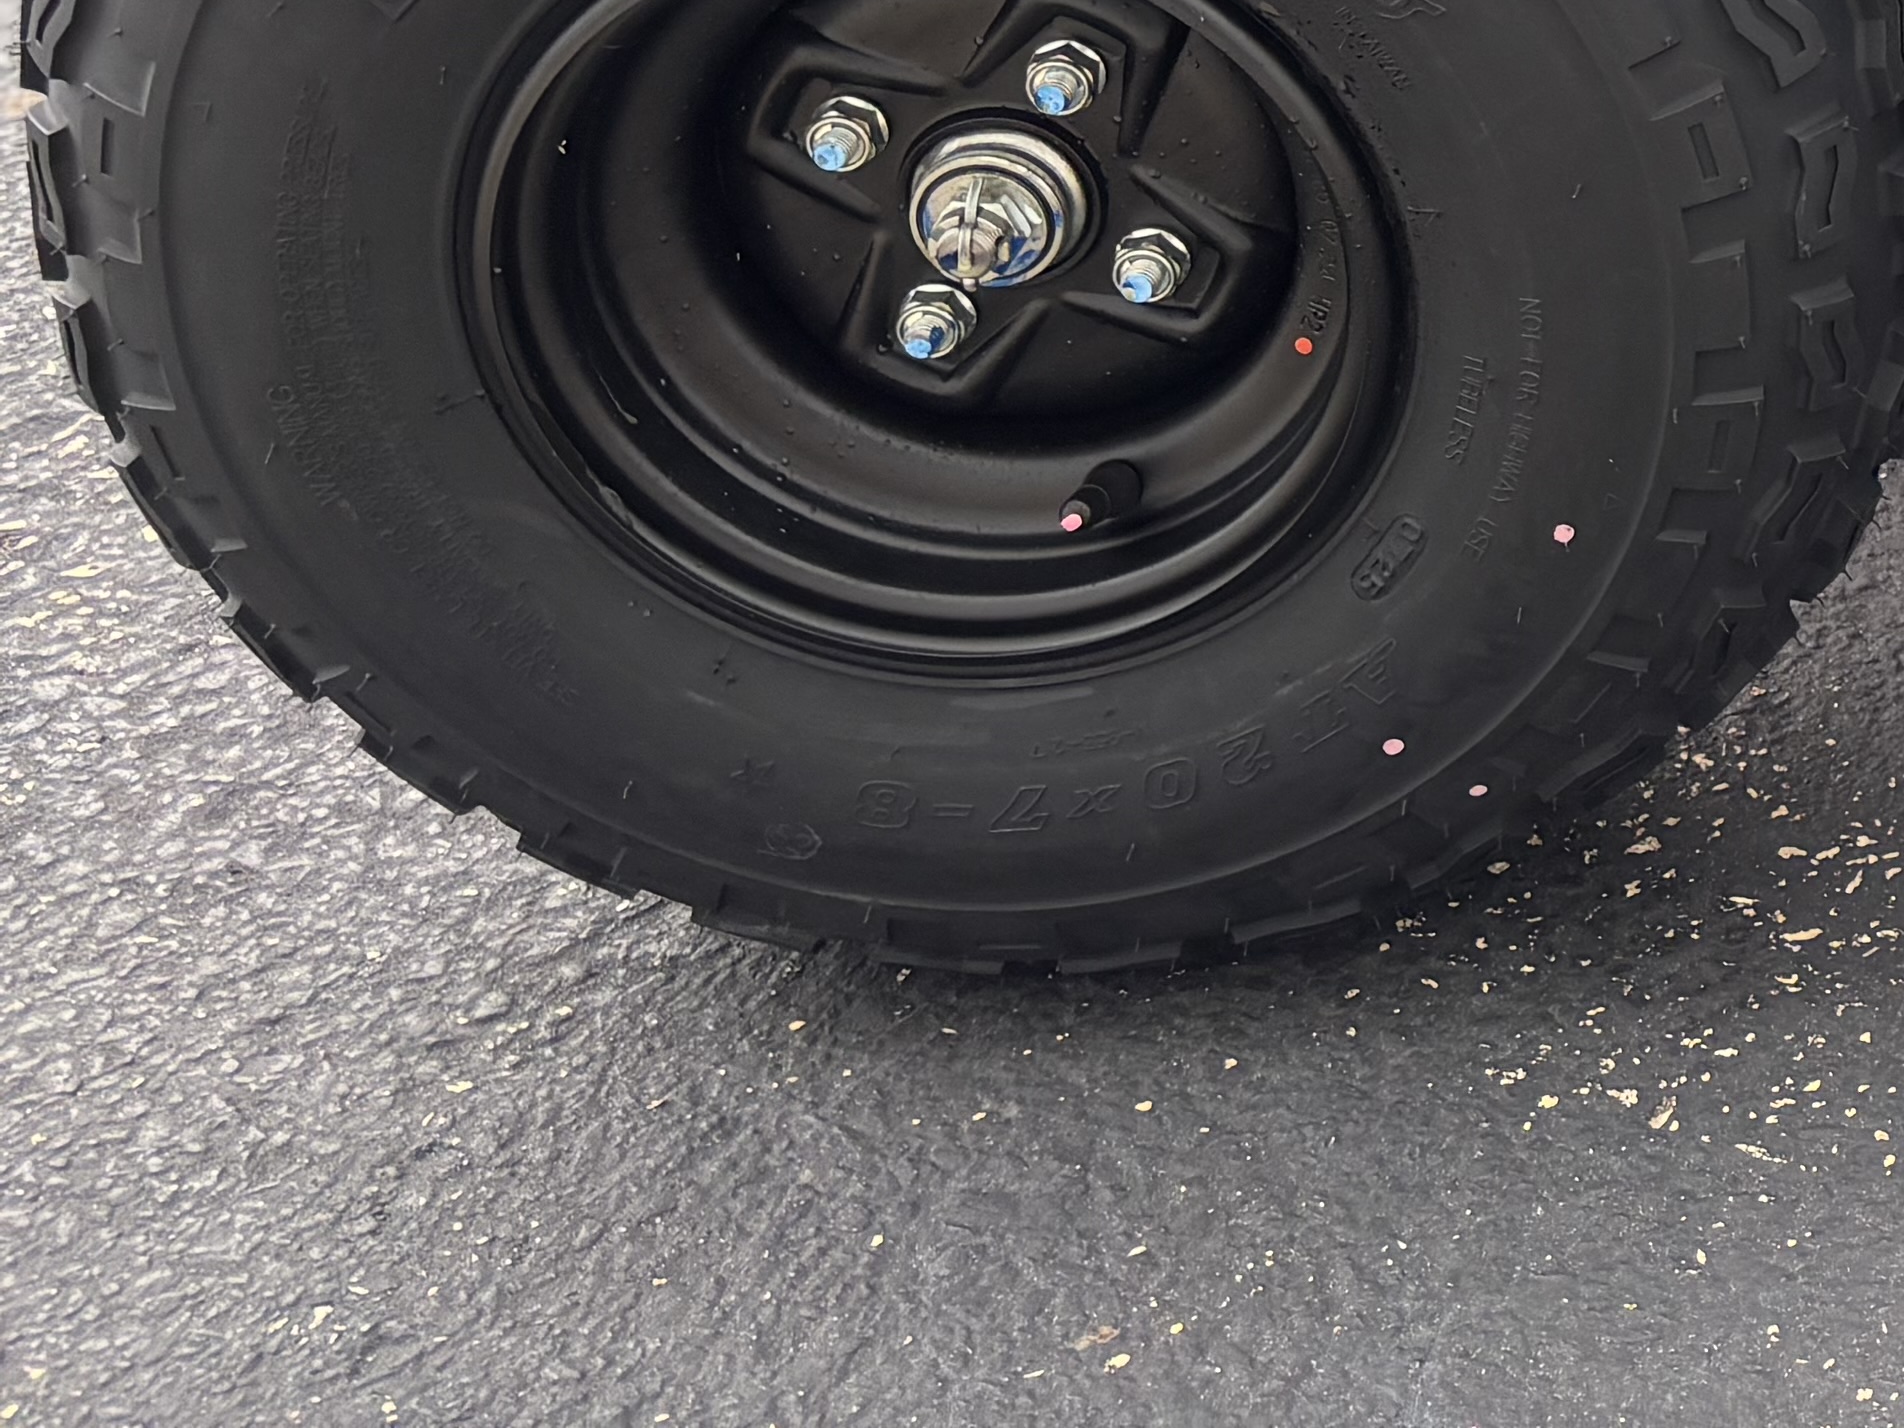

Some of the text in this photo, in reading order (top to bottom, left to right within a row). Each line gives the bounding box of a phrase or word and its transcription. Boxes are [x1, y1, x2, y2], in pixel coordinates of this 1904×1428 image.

[262, 382, 346, 509] WARNING
[1484, 410, 1540, 509] HIGHWAY
[1456, 512, 1504, 564] USE
